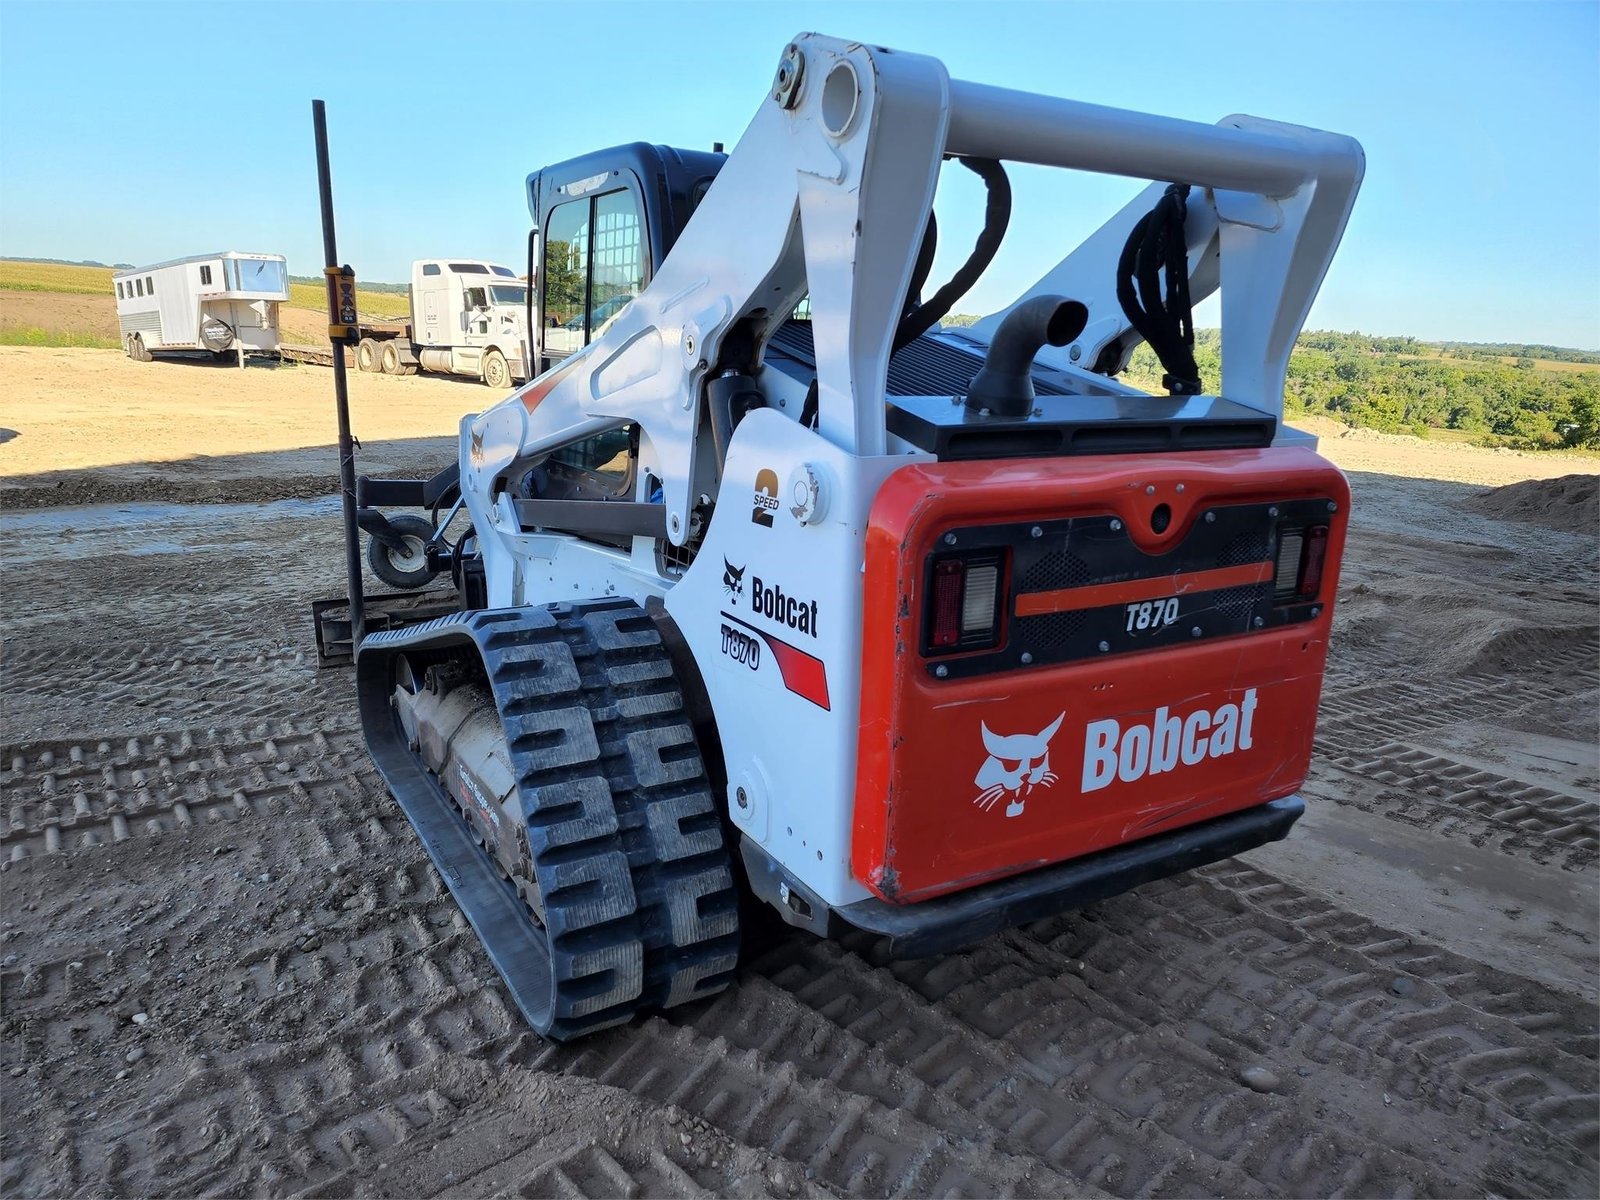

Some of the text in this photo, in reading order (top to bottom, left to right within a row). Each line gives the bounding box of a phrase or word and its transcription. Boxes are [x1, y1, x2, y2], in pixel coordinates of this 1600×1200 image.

[752, 468, 779, 529] 2
[753, 494, 780, 511] SPEED
[752, 576, 818, 639] Bobcat
[1126, 597, 1180, 632] T870
[720, 623, 761, 671] T870
[1081, 688, 1258, 794] Bobcat
